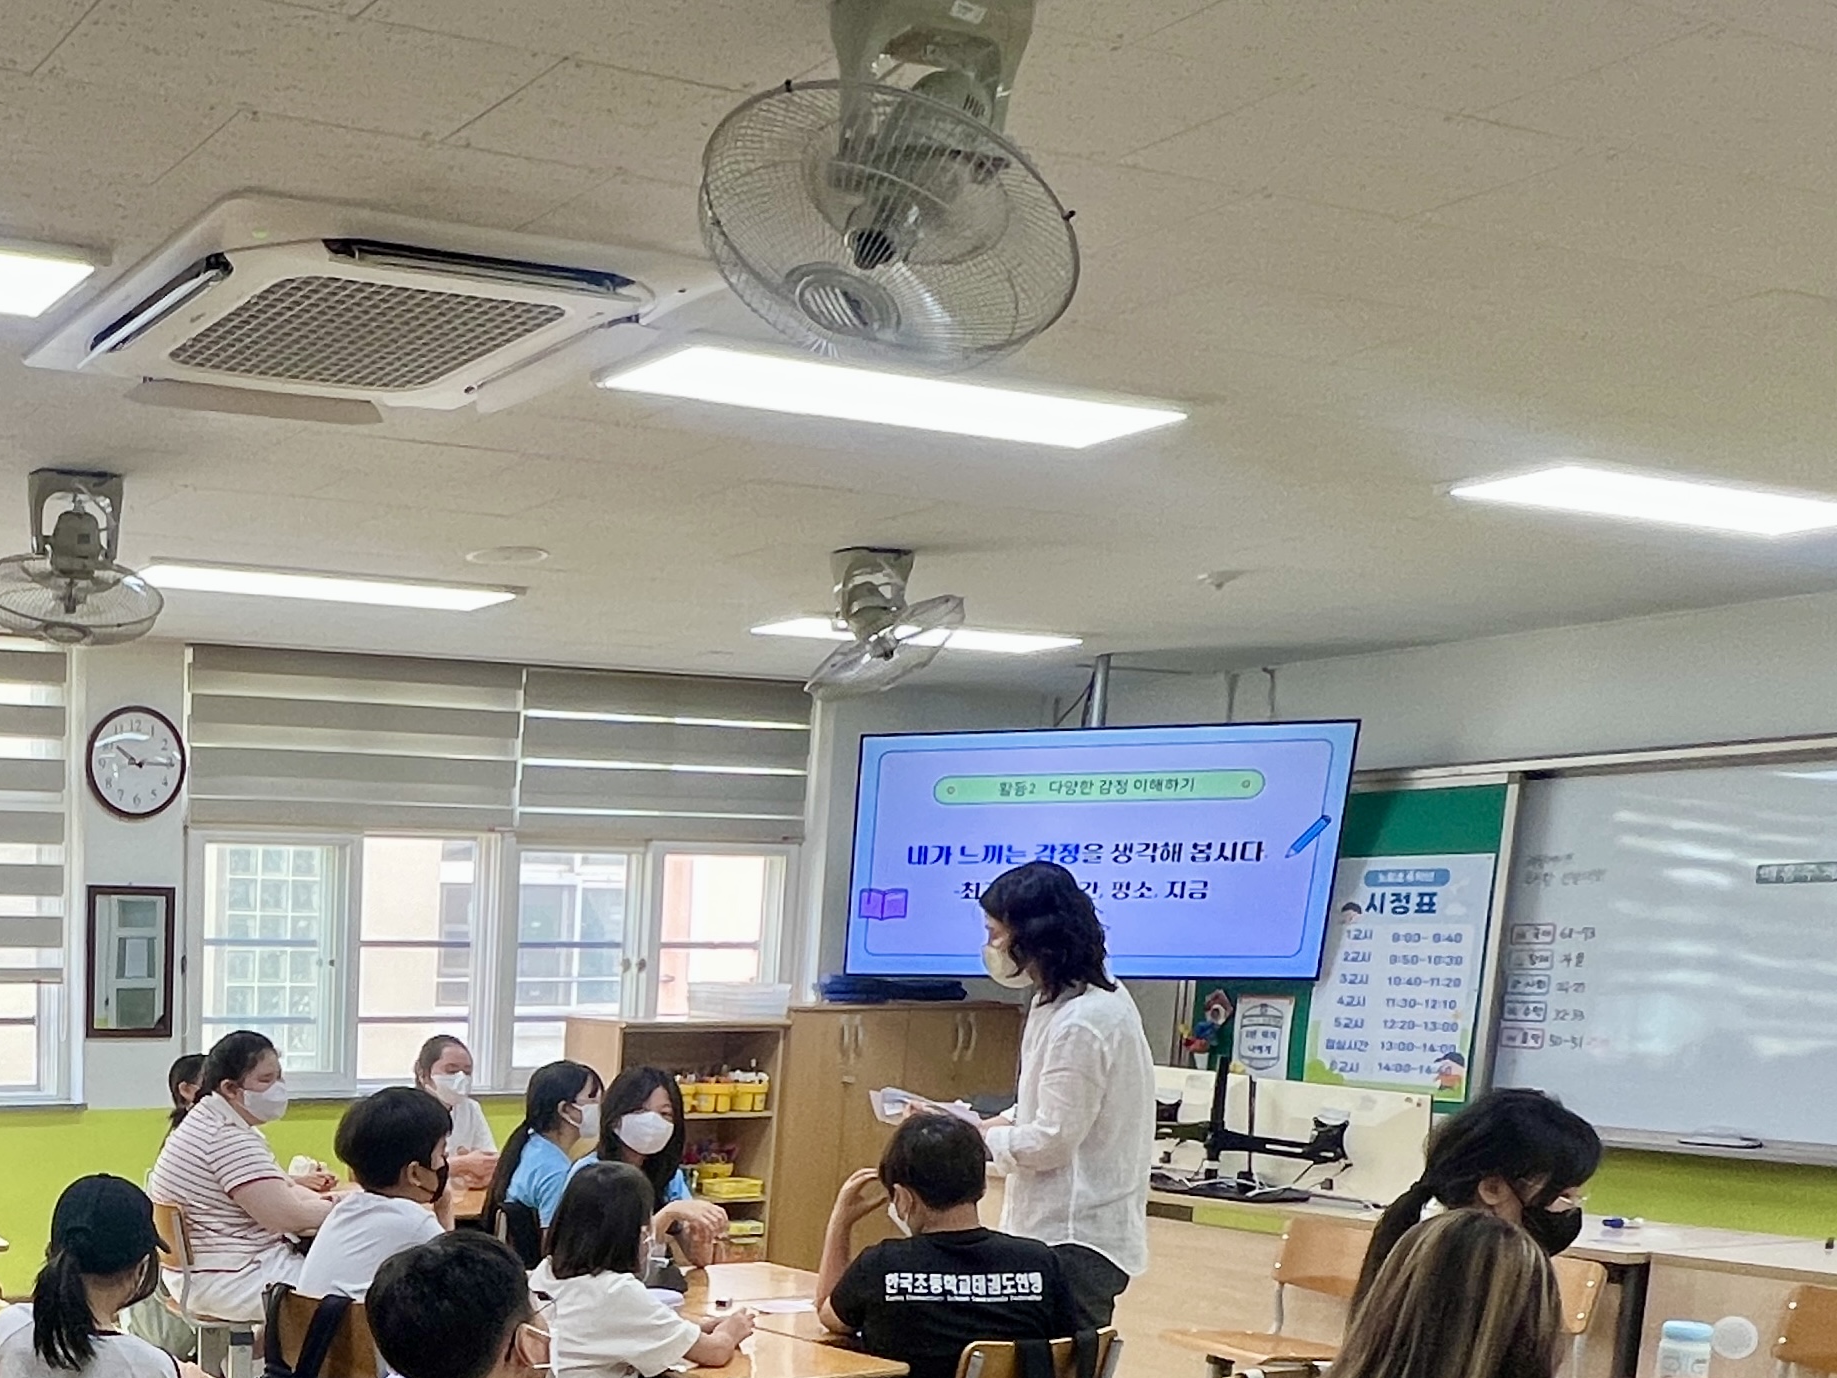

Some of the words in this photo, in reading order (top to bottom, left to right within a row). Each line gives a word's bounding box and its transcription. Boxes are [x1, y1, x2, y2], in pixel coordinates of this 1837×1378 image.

[130, 719, 142, 732] 12
[161, 738, 168, 751] 2
[98, 758, 106, 769] 9
[105, 778, 113, 789] 8
[1049, 780, 1094, 796] 다양한
[1099, 778, 1129, 795] 감정
[1133, 776, 1195, 793] 이해하기
[117, 789, 124, 801] 7
[133, 793, 141, 807] 6
[907, 845, 952, 866] 내가
[958, 843, 1027, 865] 느끼는
[1034, 842, 1104, 865] 감정을
[1110, 841, 1183, 864] 생각해
[1164, 880, 1209, 900] 지금
[1365, 891, 1439, 916] 시정표
[1336, 995, 1366, 1007] 4교시
[1334, 1017, 1364, 1029] 5교시
[884, 1271, 1043, 1295] 한국초등학교태권도연맹
